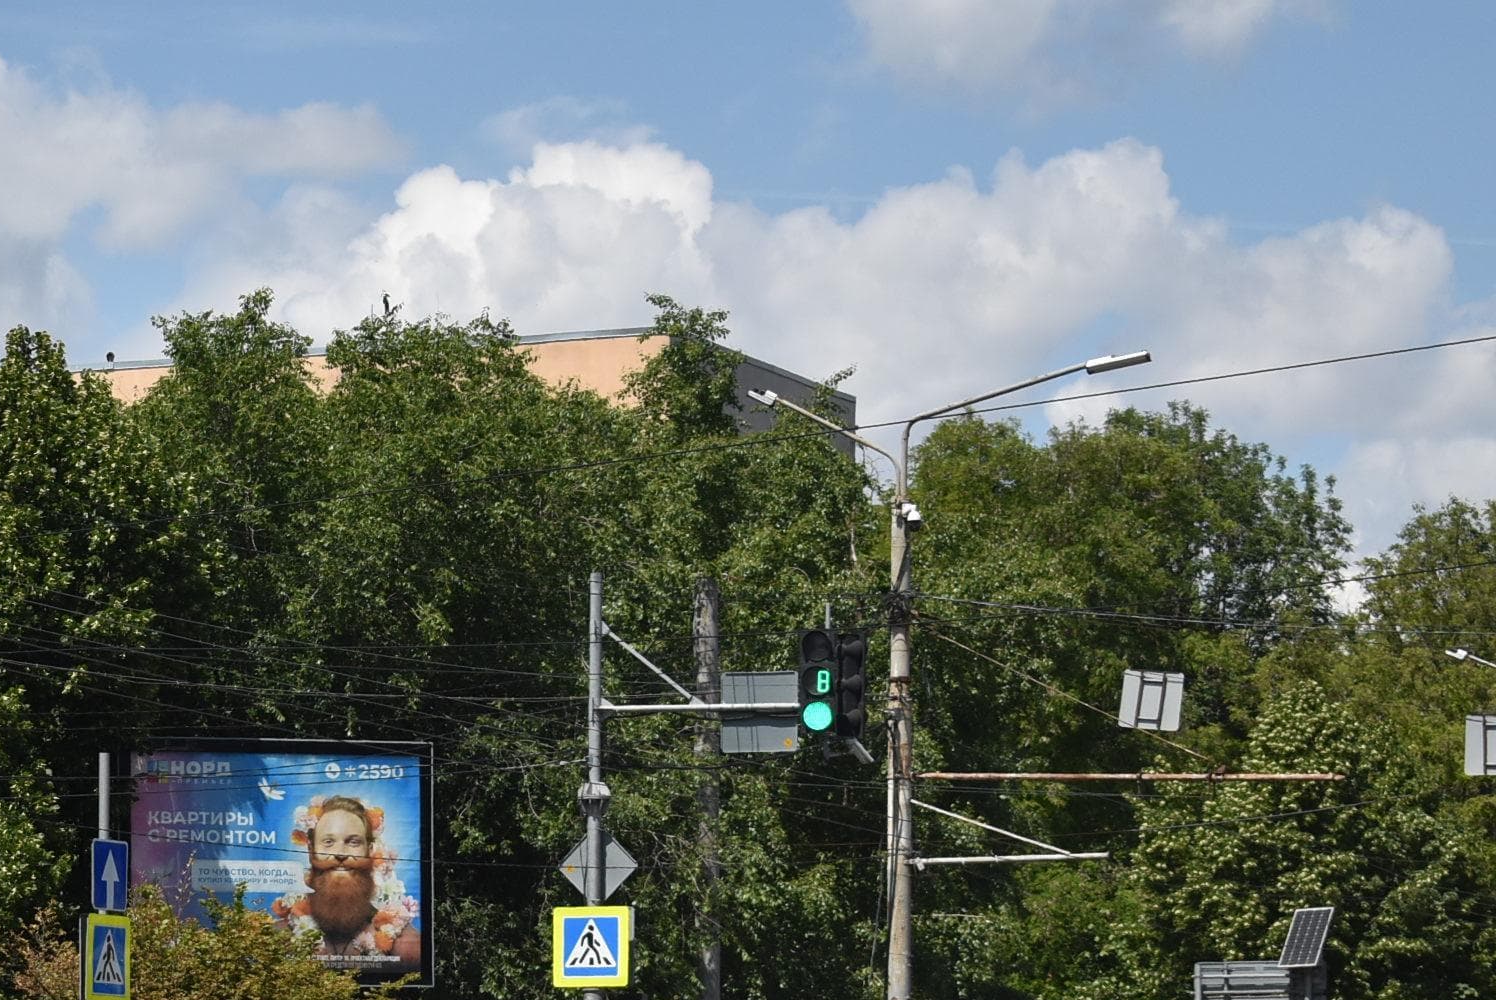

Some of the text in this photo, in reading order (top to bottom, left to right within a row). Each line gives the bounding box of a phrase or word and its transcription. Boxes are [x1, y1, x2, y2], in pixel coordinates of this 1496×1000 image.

[147, 810, 254, 826] КВАРТИРЫ
[148, 829, 276, 844] С РЕМОНТОМ
